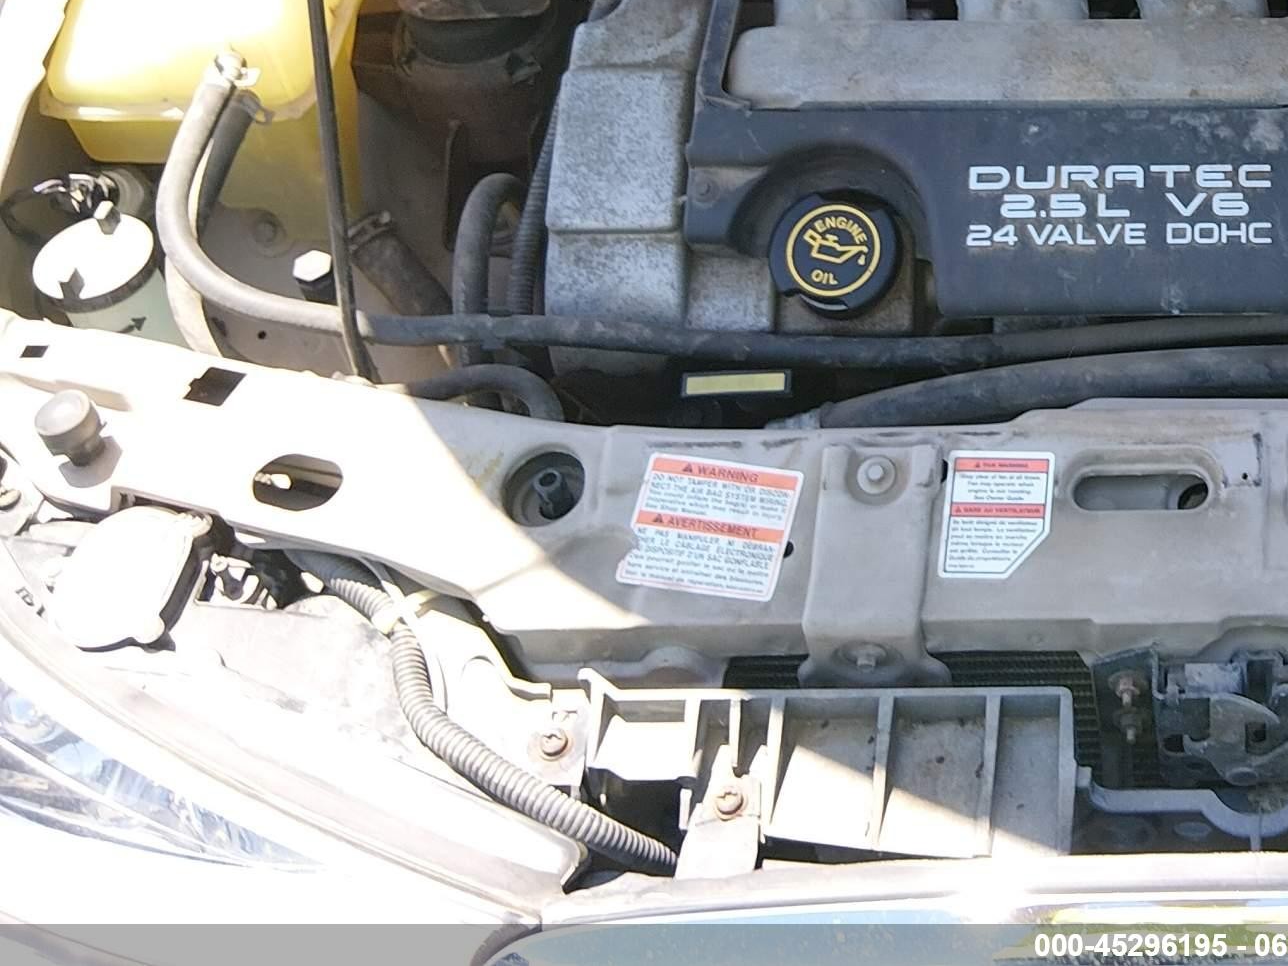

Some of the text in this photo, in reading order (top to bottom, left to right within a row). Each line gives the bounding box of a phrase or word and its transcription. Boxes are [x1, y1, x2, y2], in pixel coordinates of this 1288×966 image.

[967, 164, 1272, 191] DURATEC
[1163, 193, 1250, 217] V6
[814, 216, 868, 244] ENGINE
[965, 222, 1273, 247] 24 VALVE DOHC
[811, 269, 838, 285] OIL
[698, 464, 759, 483] WARNING
[668, 517, 758, 538] AVERTISSEMENT
